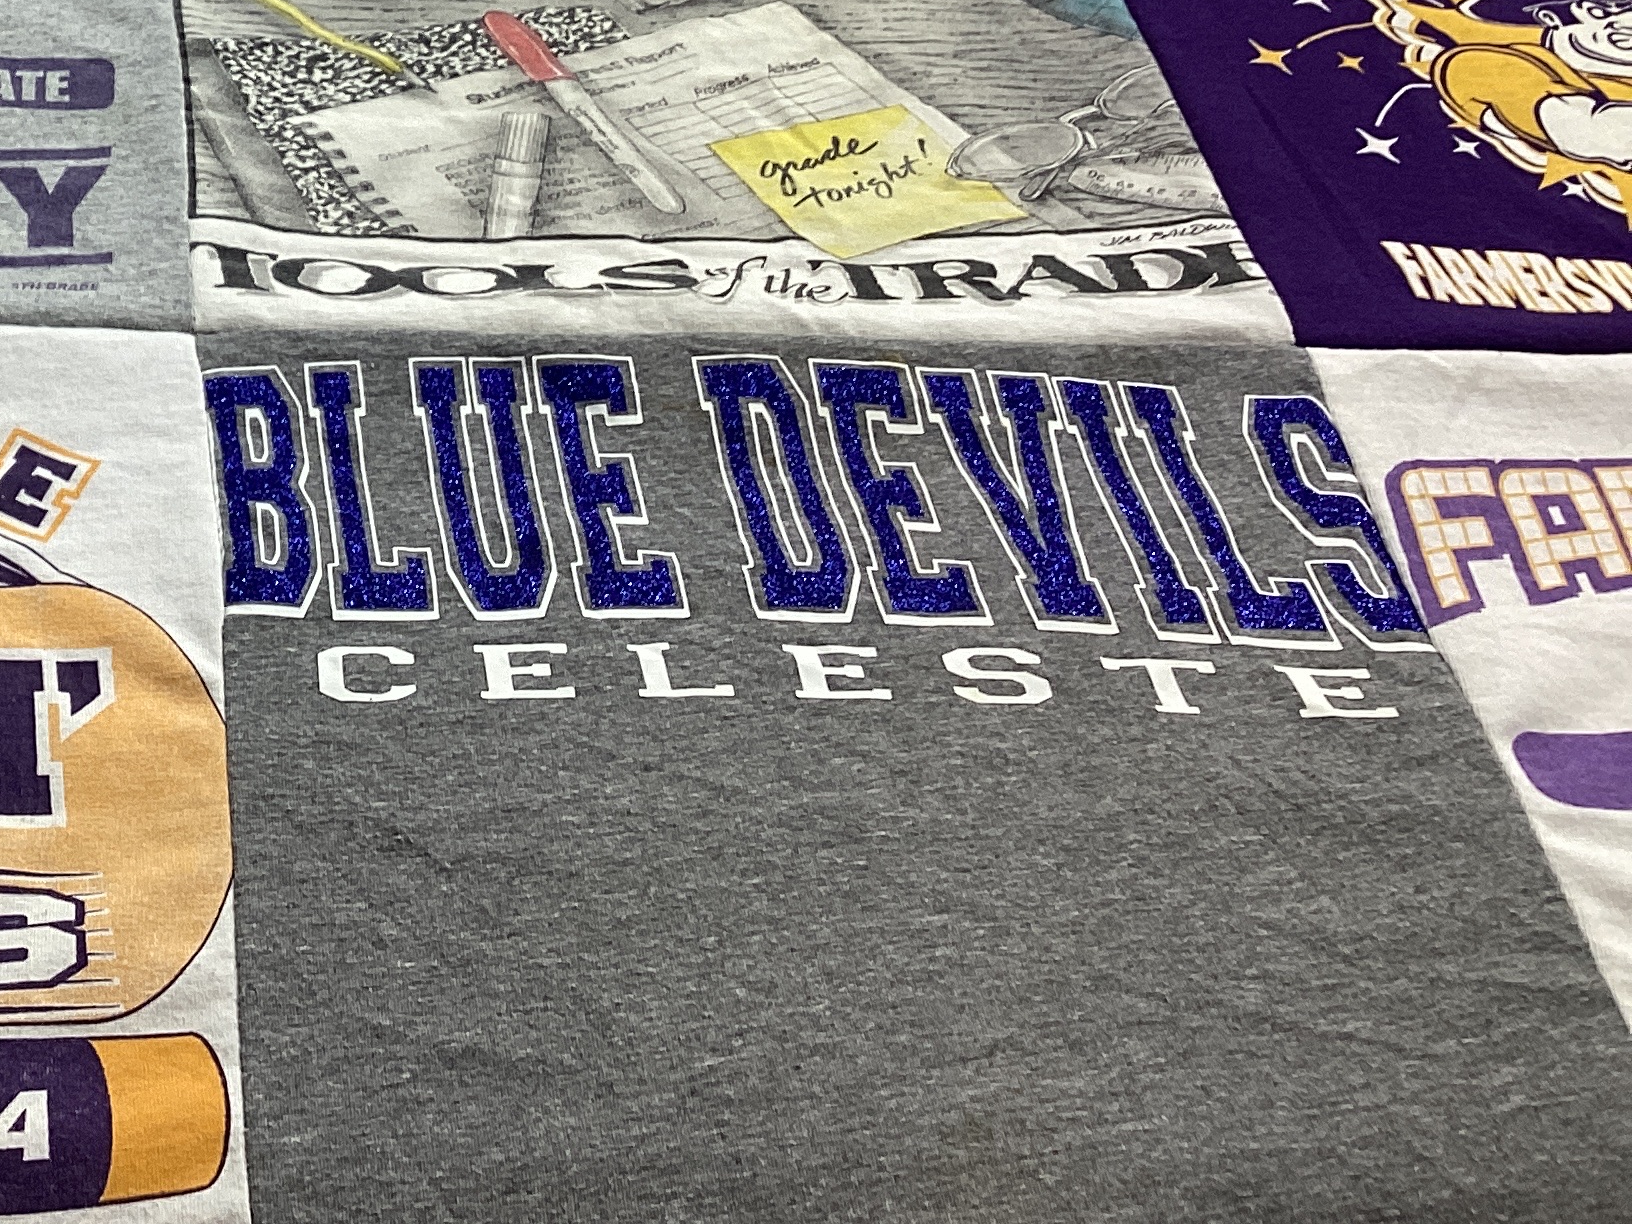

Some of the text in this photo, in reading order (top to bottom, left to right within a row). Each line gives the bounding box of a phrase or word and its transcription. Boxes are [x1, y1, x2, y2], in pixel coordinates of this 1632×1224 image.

[759, 135, 880, 197] grade
[794, 138, 928, 210] tonight!
[190, 241, 700, 296] TOOLS
[693, 255, 768, 298] of
[764, 268, 849, 304] the
[211, 355, 1441, 654] BLUE DEVILS
[314, 640, 1400, 720] CELESTE
